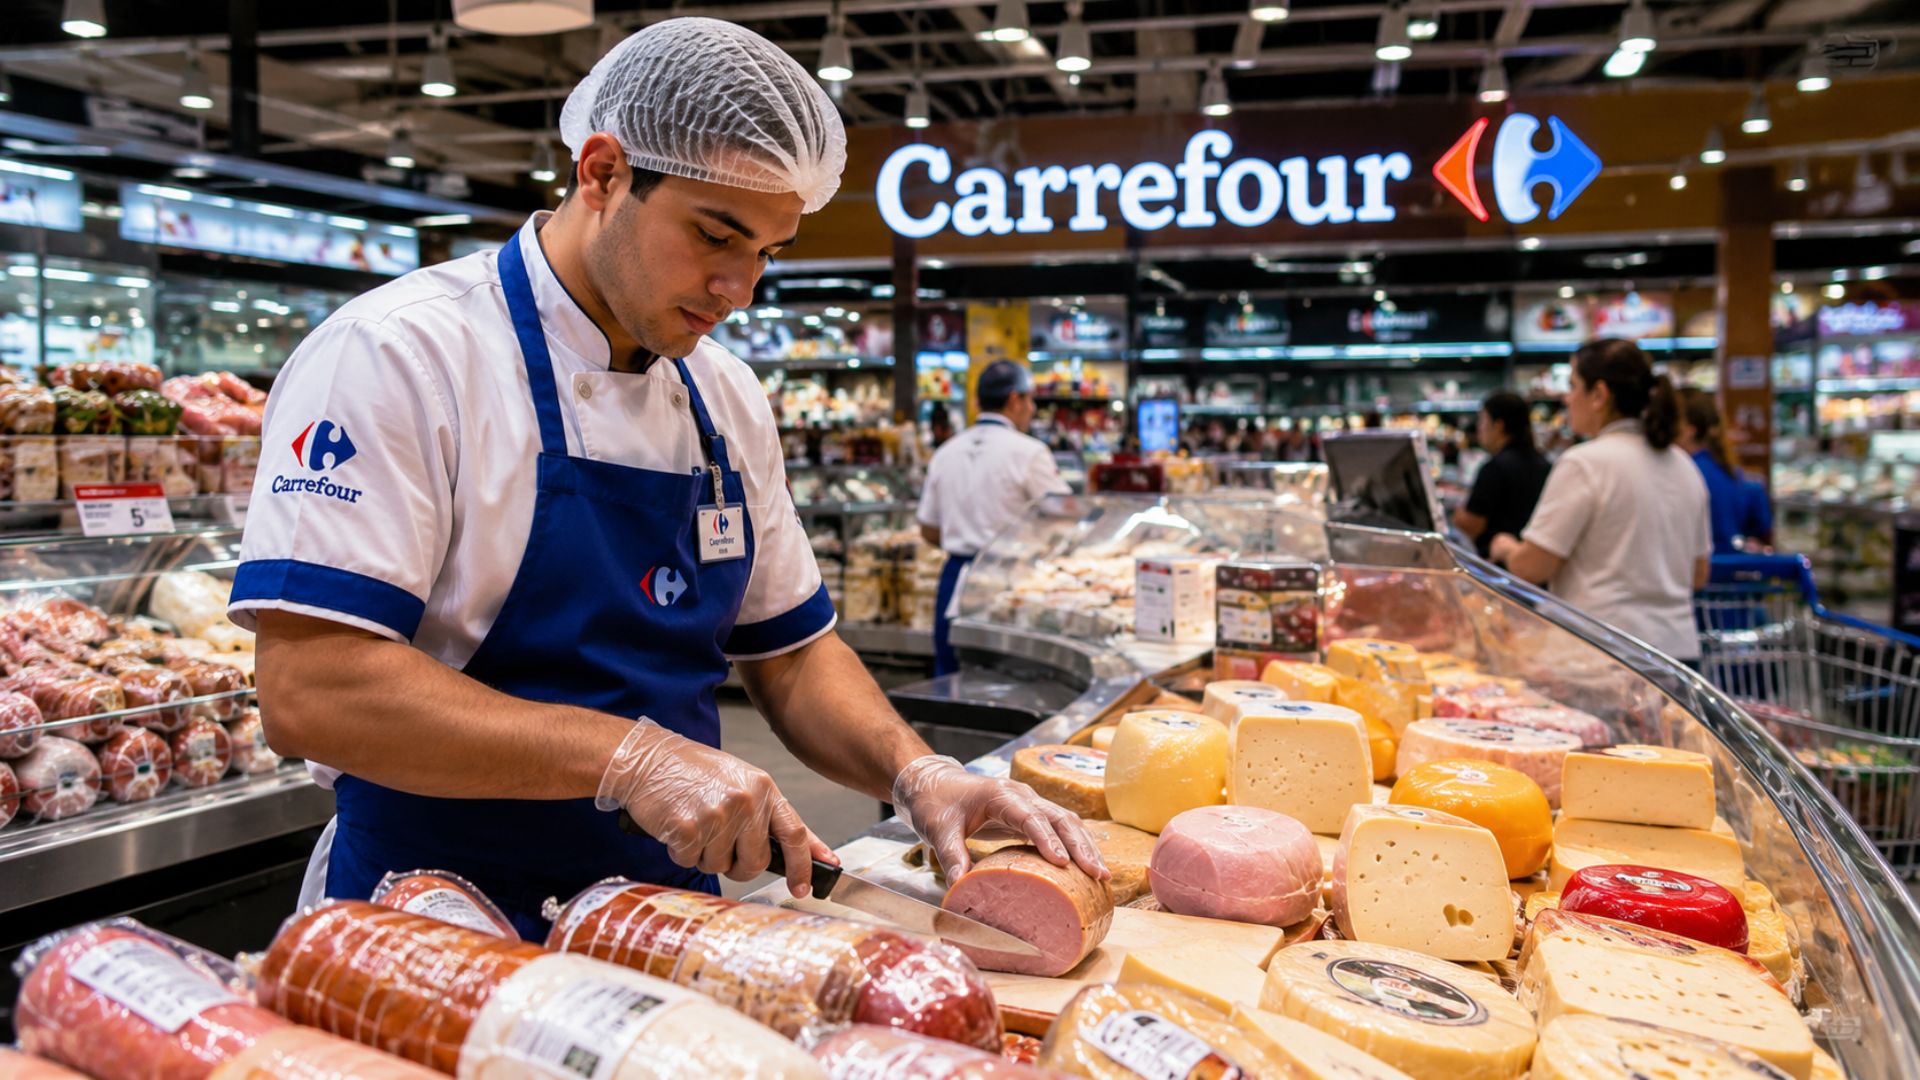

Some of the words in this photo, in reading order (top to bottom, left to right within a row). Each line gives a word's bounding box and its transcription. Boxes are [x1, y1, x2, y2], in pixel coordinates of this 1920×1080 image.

[876, 129, 1411, 238] Carrefour
[272, 475, 362, 503] Carrefour
[131, 508, 145, 528] 5
